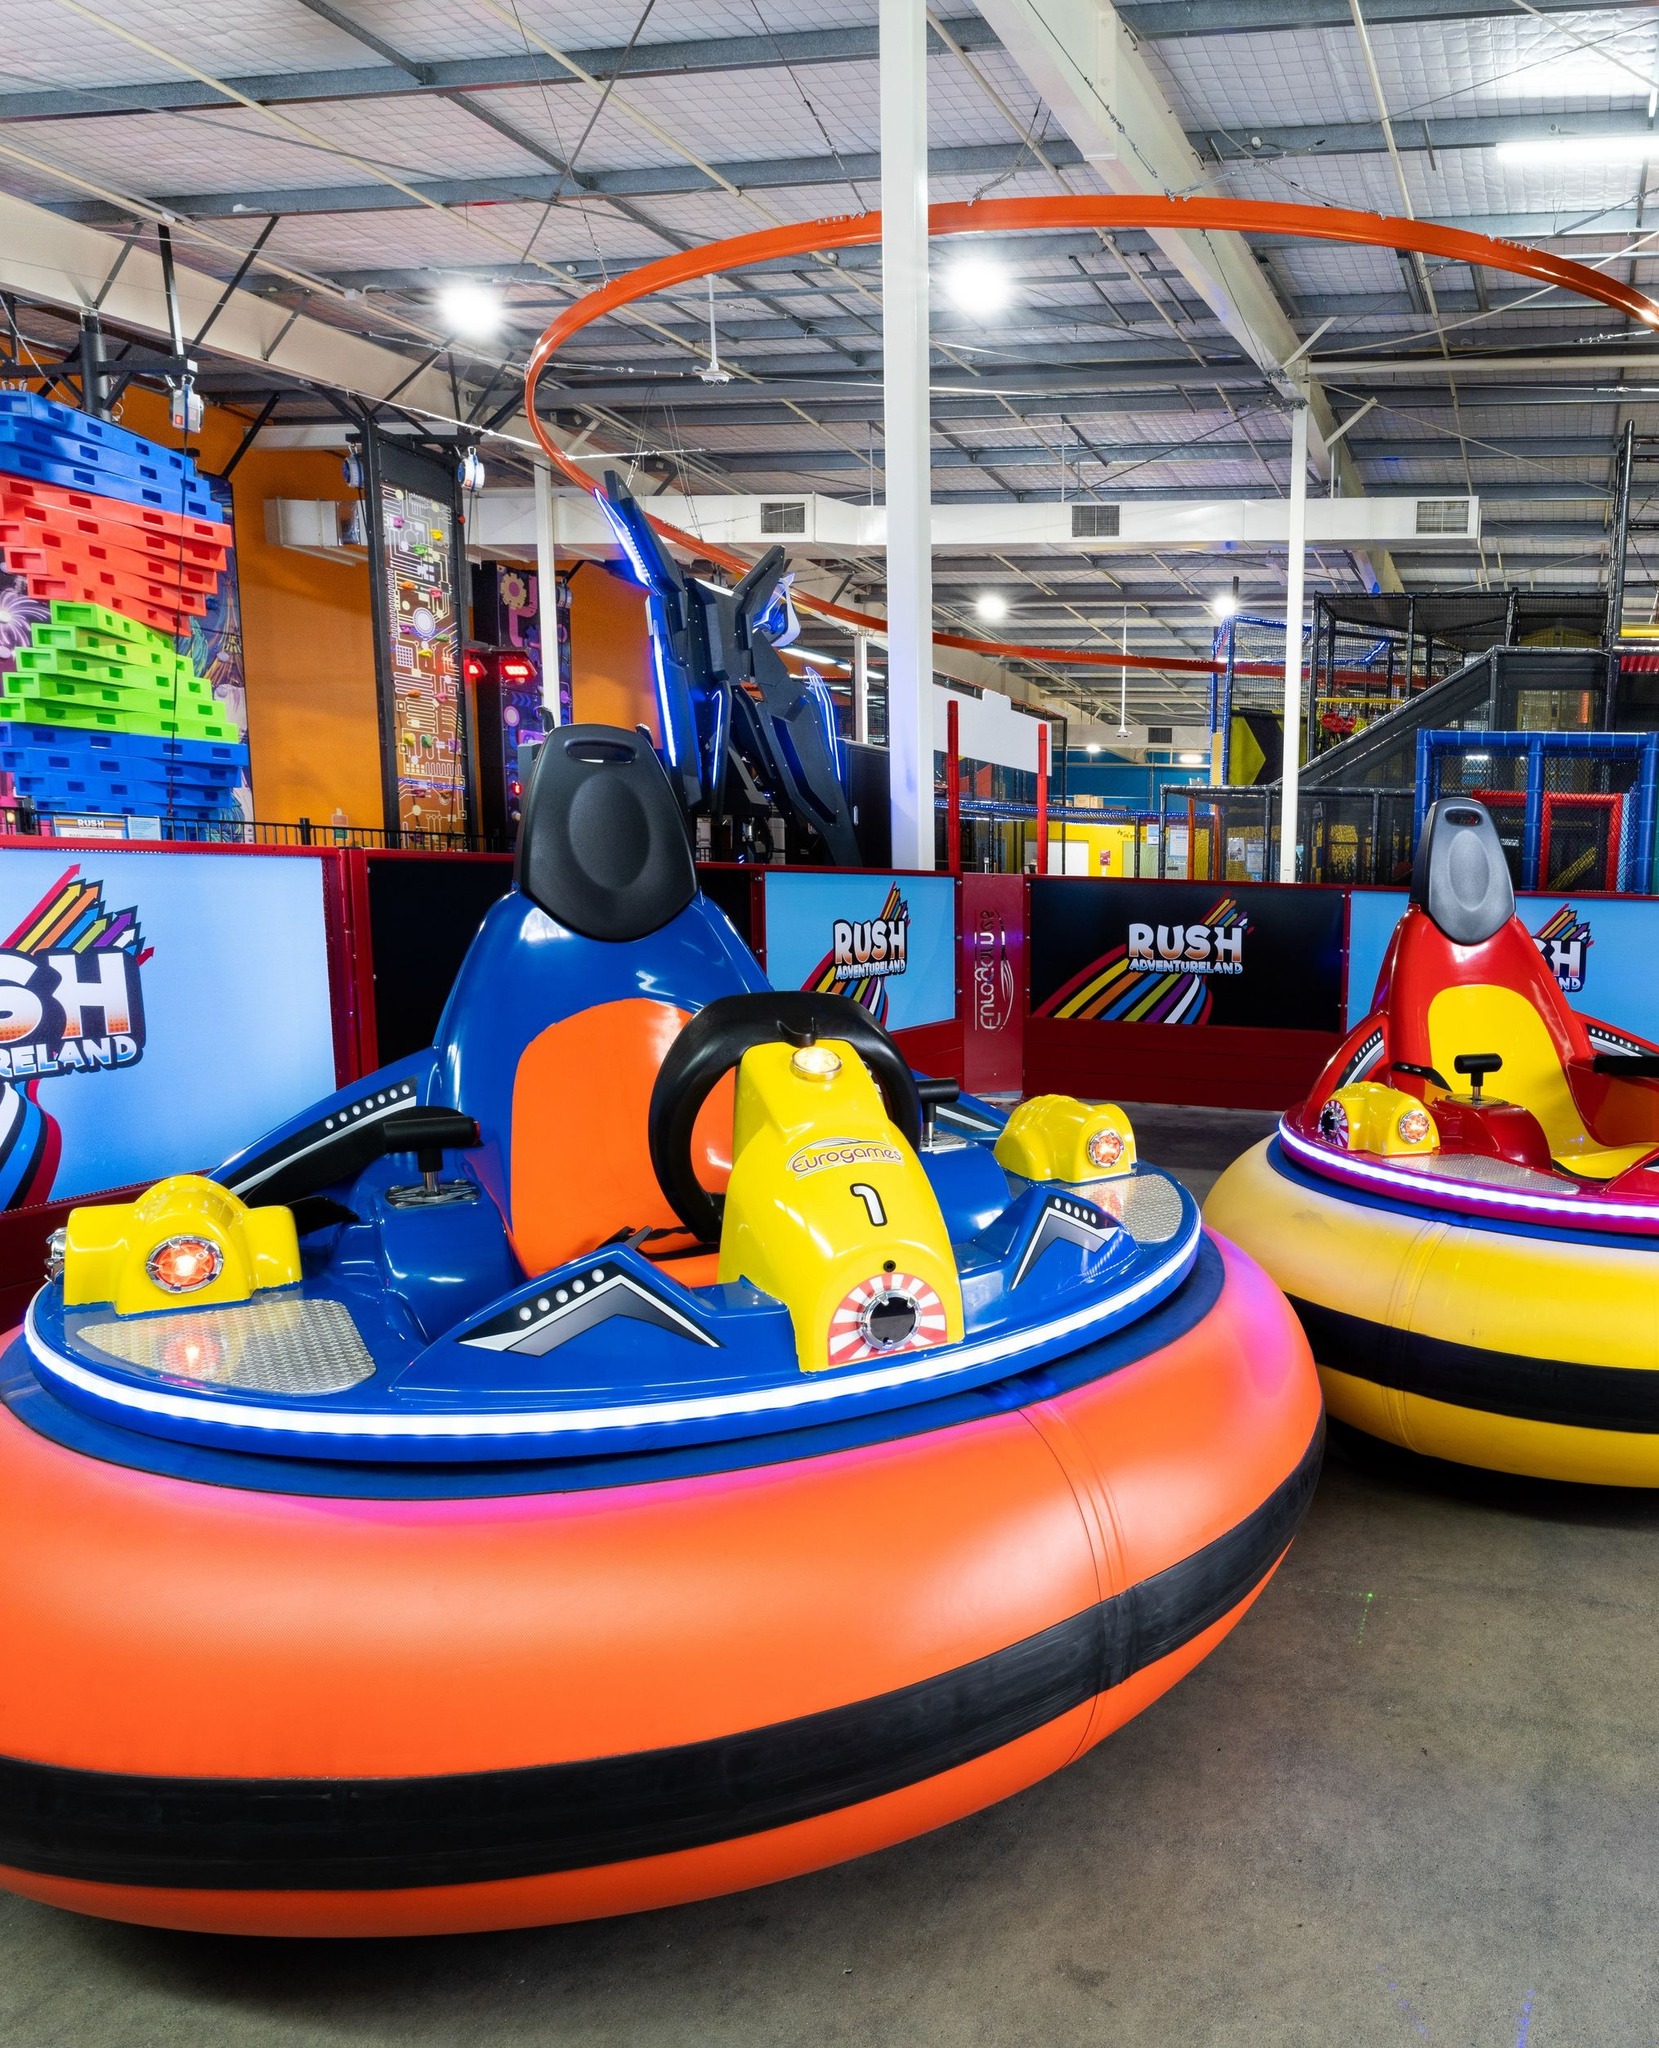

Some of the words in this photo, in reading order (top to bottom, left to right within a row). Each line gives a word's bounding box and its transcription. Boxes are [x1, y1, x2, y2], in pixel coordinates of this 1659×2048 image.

[77, 819, 104, 828] RUSH
[834, 920, 905, 965] RUSH
[1128, 923, 1242, 963] RUSH
[835, 959, 906, 980] ADVENTURELAND
[1128, 958, 1243, 974] ADVENTURELAND
[792, 1147, 902, 1173] Eurogames
[849, 1183, 887, 1227] 1
